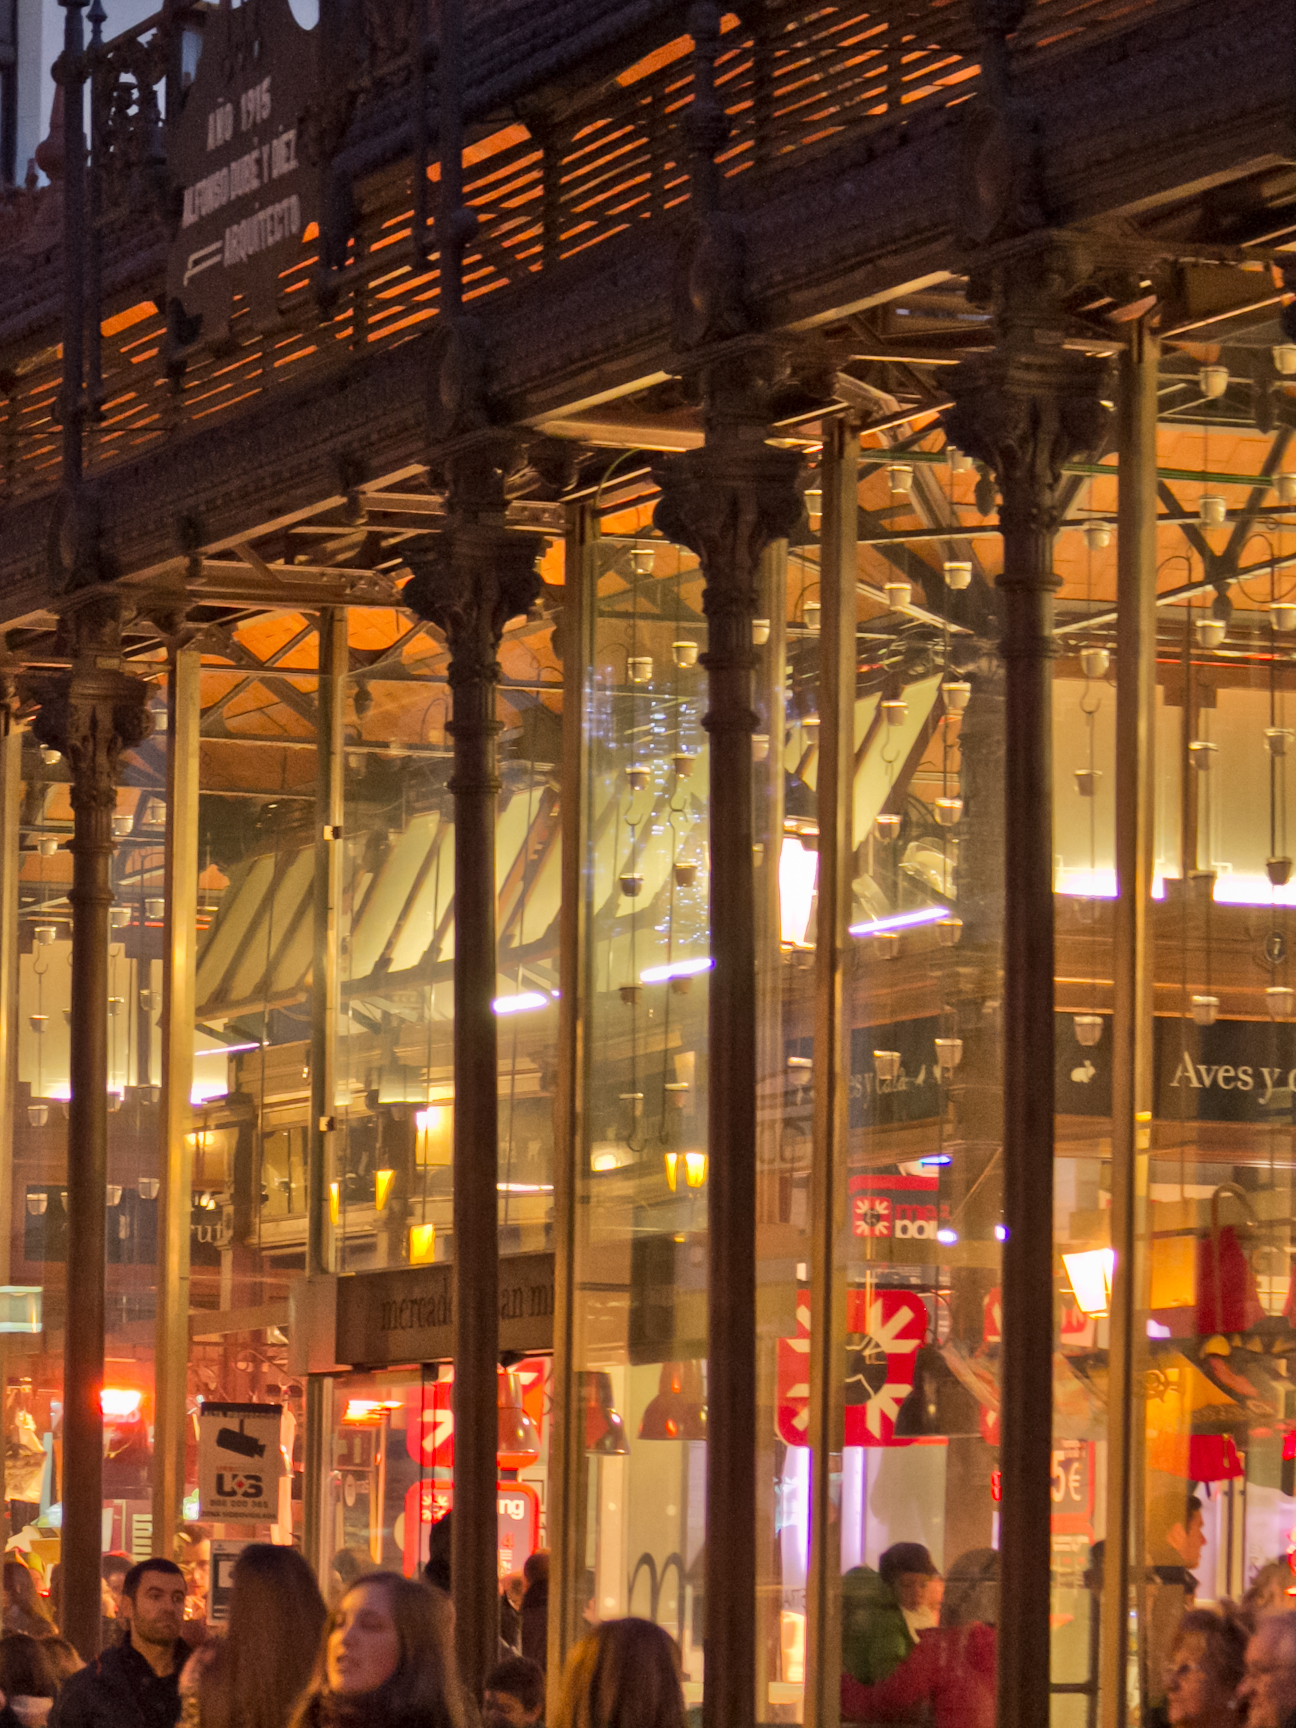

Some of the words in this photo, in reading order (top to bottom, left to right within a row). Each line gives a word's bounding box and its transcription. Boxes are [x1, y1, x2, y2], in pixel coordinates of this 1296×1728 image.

[223, 194, 301, 267] ARQUITECTO
[1168, 1051, 1255, 1091] Aves
[1257, 1067, 1282, 1105] y
[381, 1276, 453, 1331] mercad
